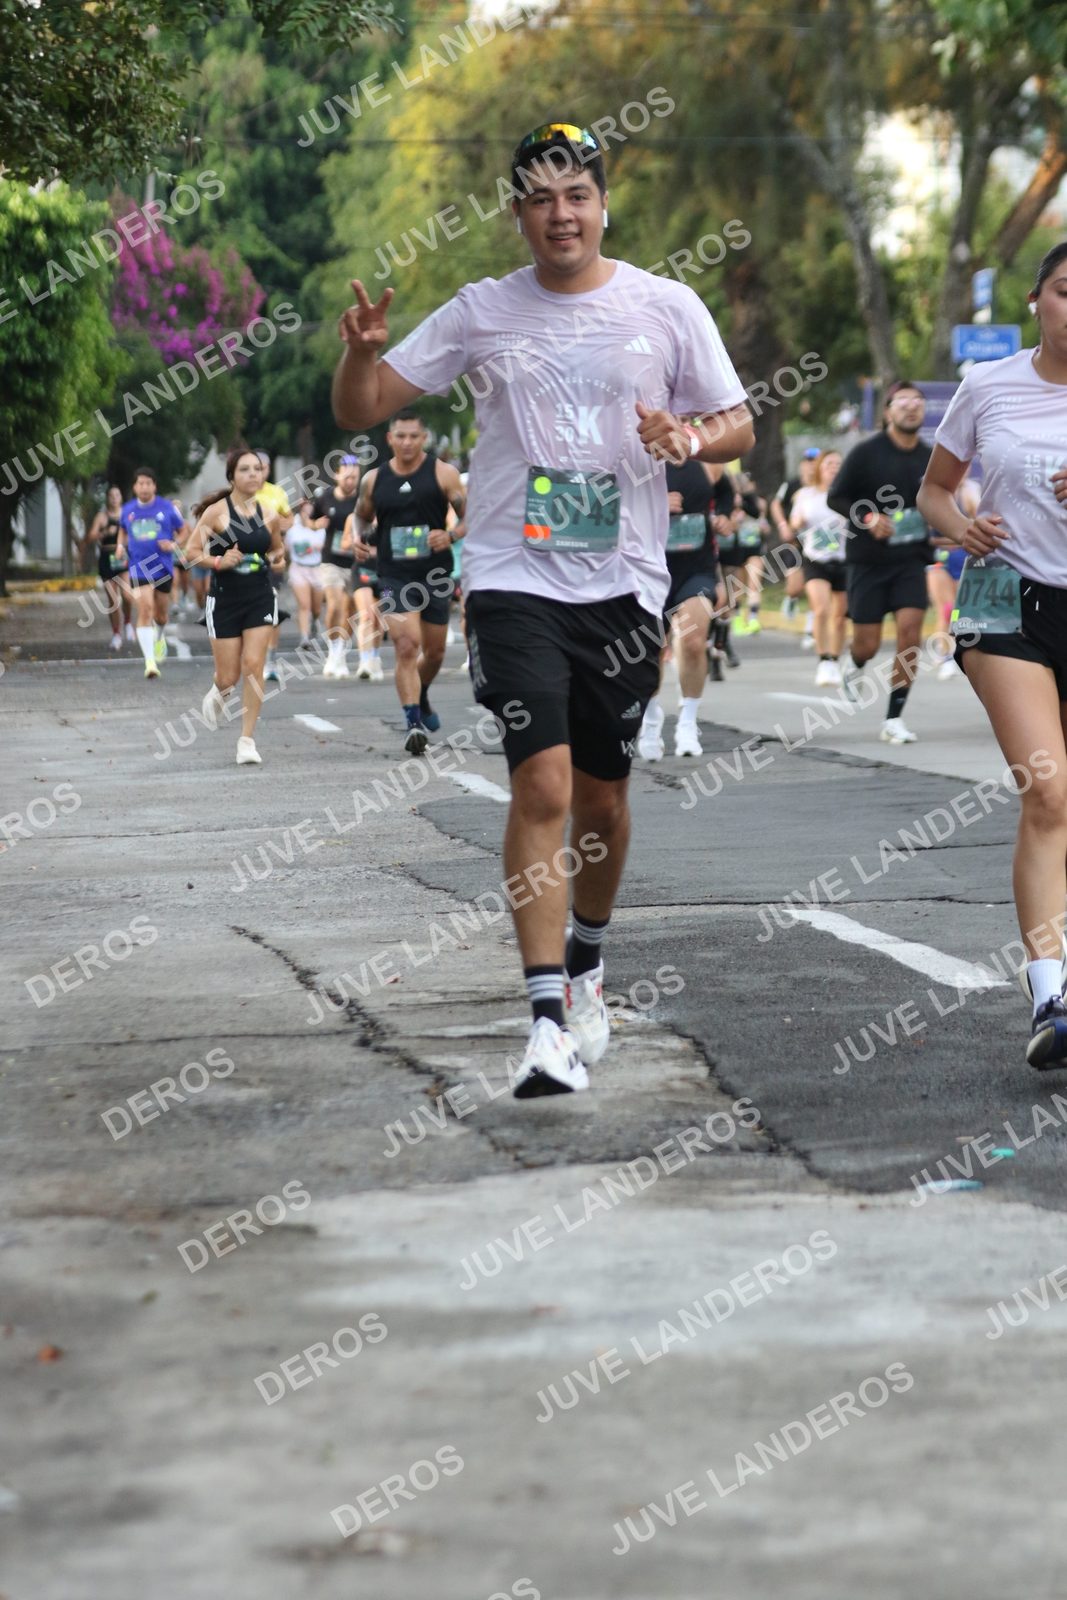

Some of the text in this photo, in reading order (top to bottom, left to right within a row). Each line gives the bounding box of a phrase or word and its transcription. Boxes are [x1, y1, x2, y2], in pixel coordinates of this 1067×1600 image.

[556, 403, 574, 418] 15
[578, 406, 603, 445] K
[555, 426, 574, 443] 30
[1024, 454, 1041, 468] 15
[1024, 472, 1041, 487] 30
[551, 495, 617, 527] 0743
[958, 577, 1017, 608] 0744
